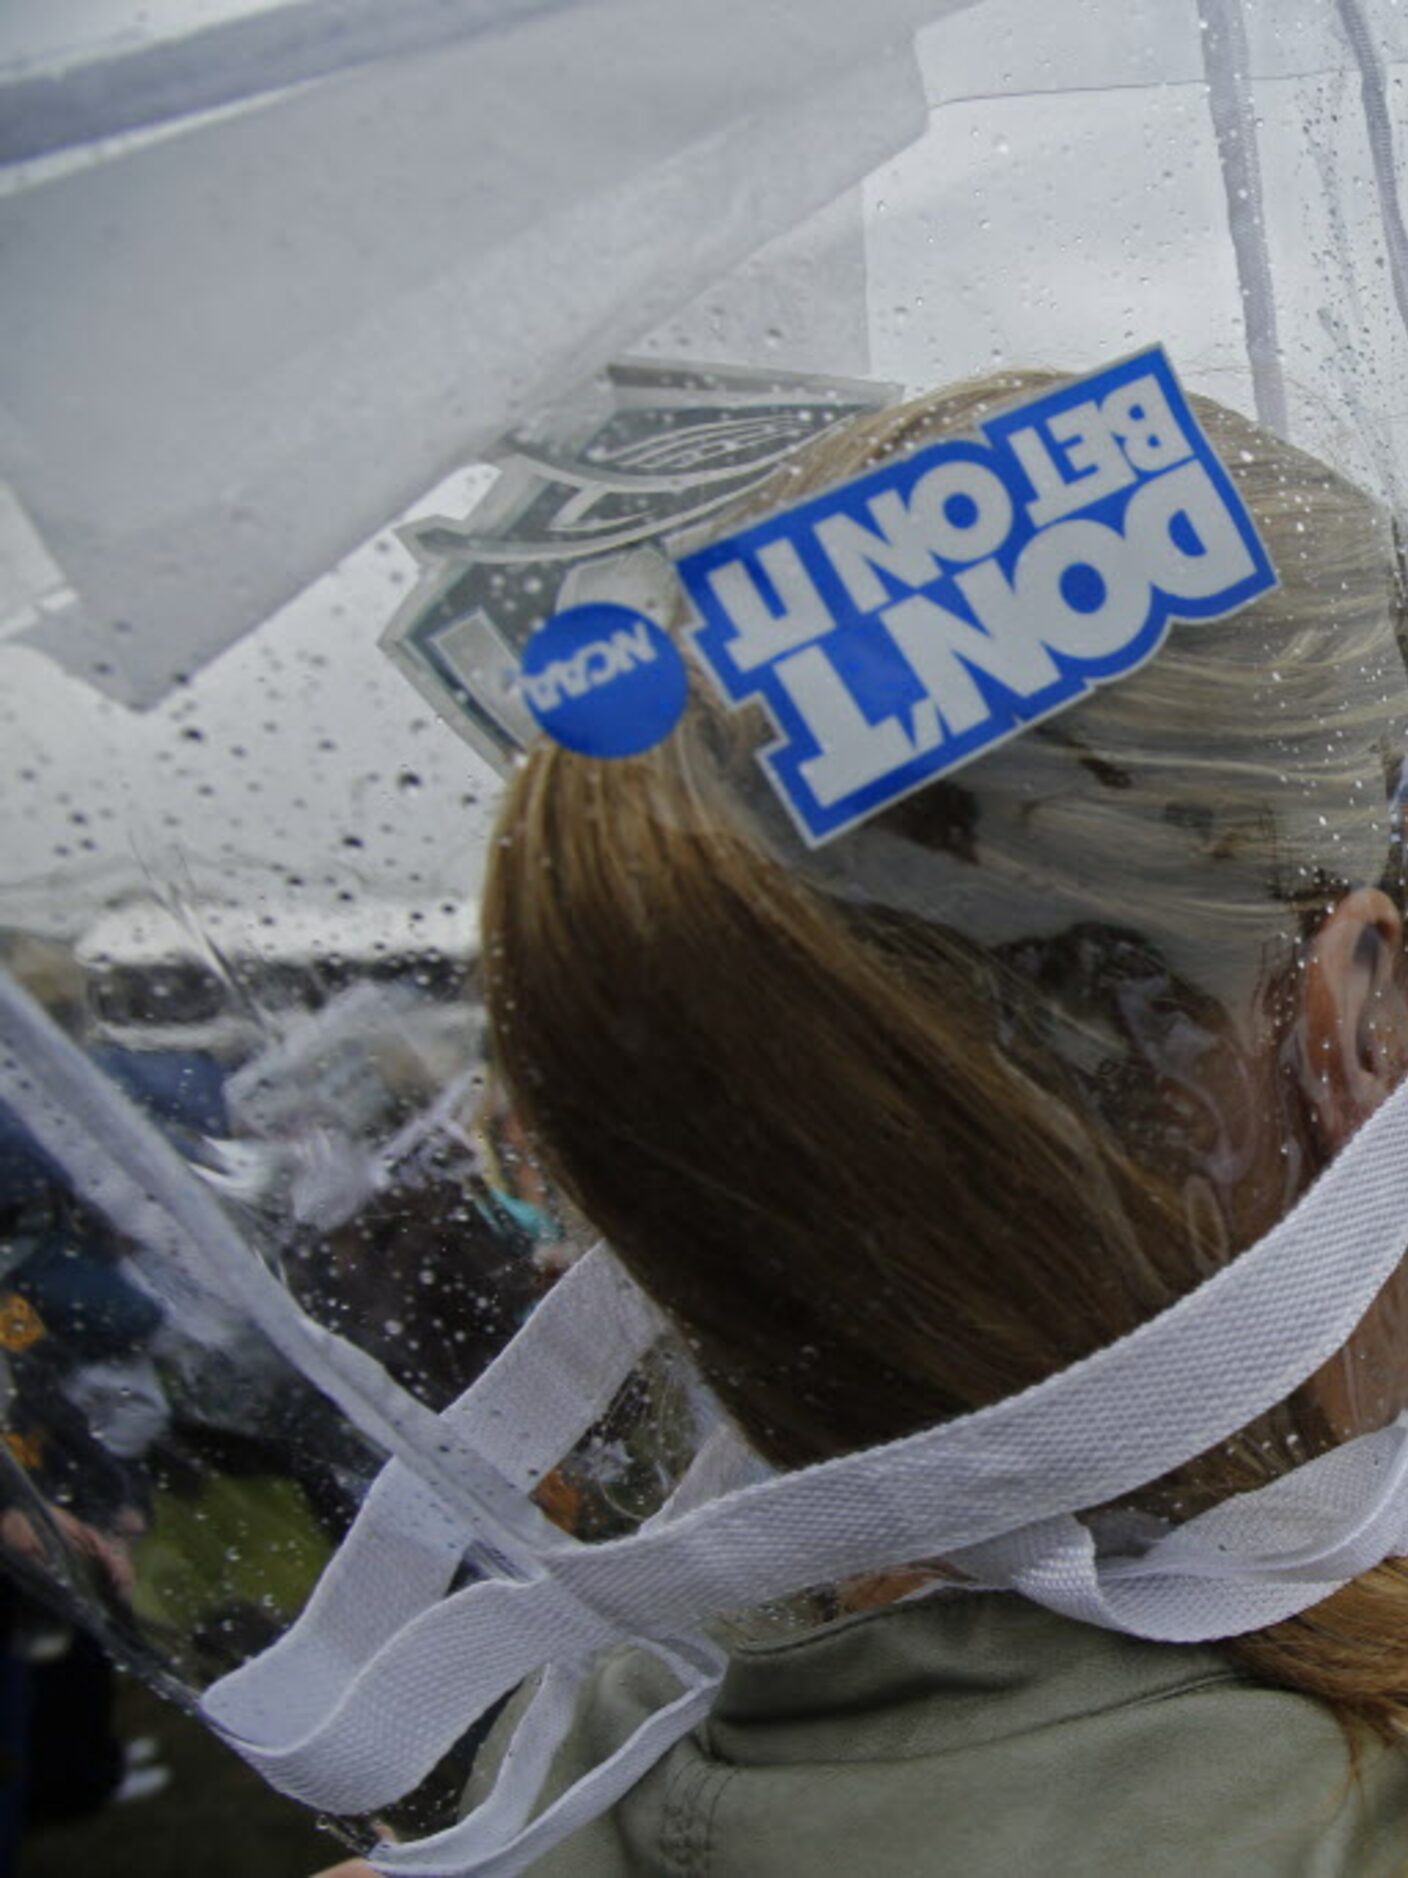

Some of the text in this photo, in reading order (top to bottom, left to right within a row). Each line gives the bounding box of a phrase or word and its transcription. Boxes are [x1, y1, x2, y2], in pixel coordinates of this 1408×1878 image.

[513, 620, 657, 712] NCAA
[707, 374, 1194, 673] BET ON IT
[773, 459, 1258, 809] DON'T
